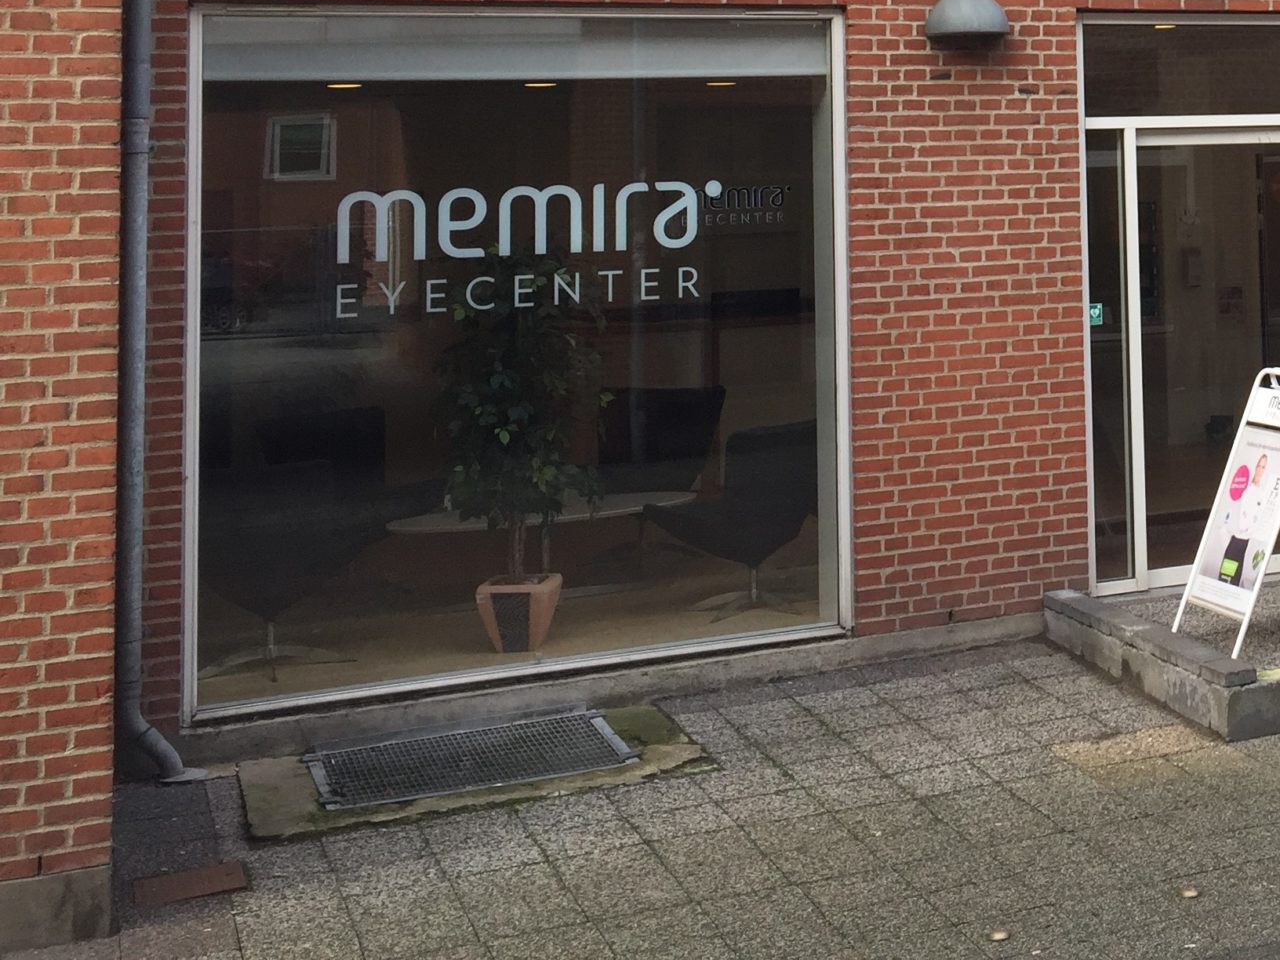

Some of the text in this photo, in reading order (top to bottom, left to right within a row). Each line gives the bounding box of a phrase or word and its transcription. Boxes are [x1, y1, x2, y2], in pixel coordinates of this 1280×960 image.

[337, 180, 722, 264] memira
[681, 211, 784, 226] EECENTER
[336, 266, 699, 318] EYECENTER
